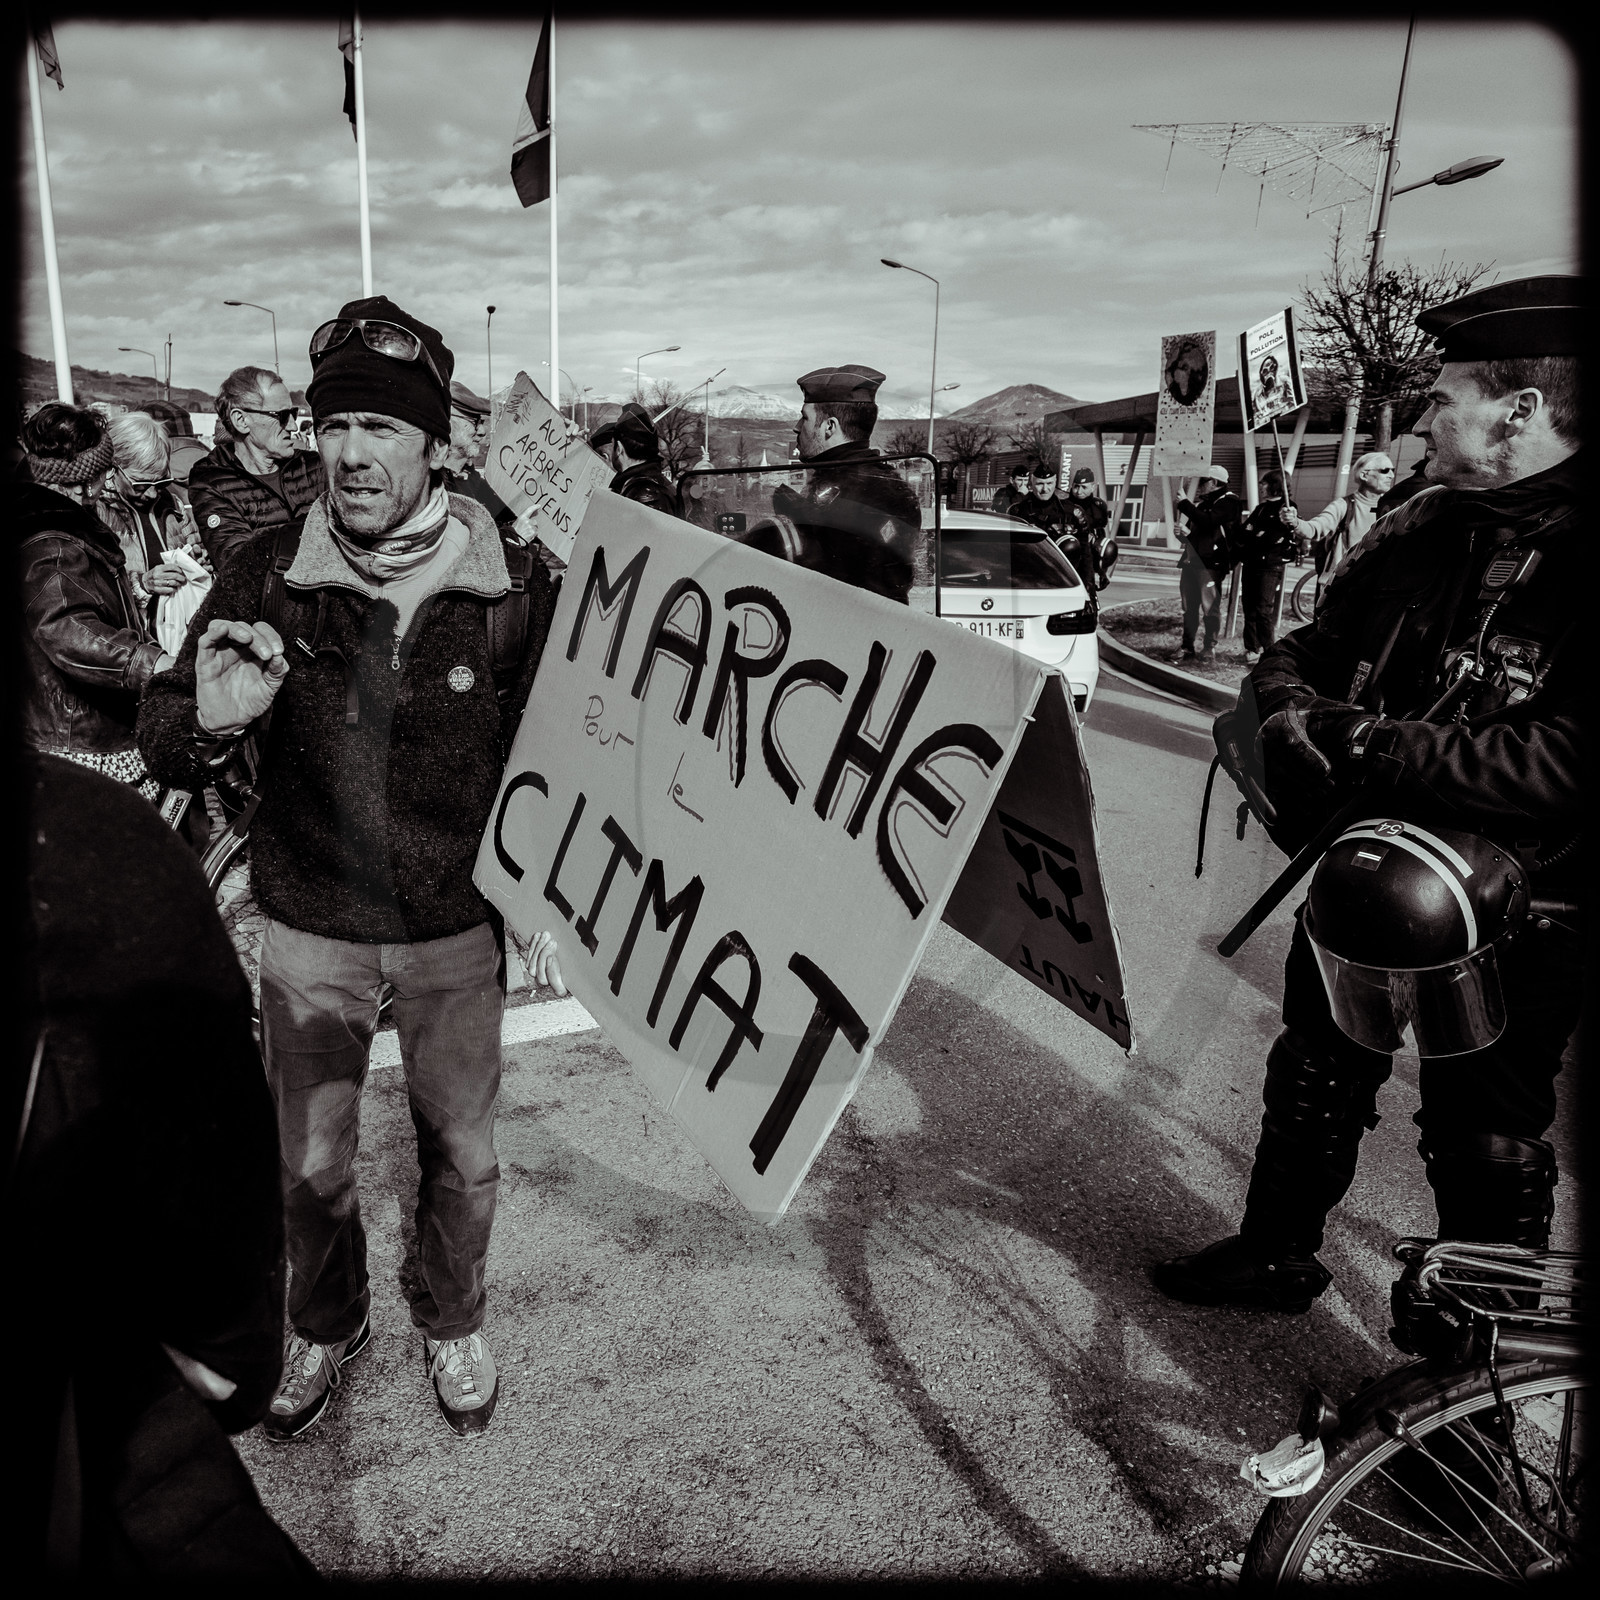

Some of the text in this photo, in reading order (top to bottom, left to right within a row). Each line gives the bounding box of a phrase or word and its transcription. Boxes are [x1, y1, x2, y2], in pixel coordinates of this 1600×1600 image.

[1250, 334, 1284, 356] POLLUTION
[1258, 328, 1275, 341] POLE
[538, 418, 572, 459] AUX
[515, 433, 574, 494] ARBRES
[566, 545, 1005, 920] MARCHE
[1377, 822, 1403, 835] 54
[493, 770, 870, 1176] CLIMAT
